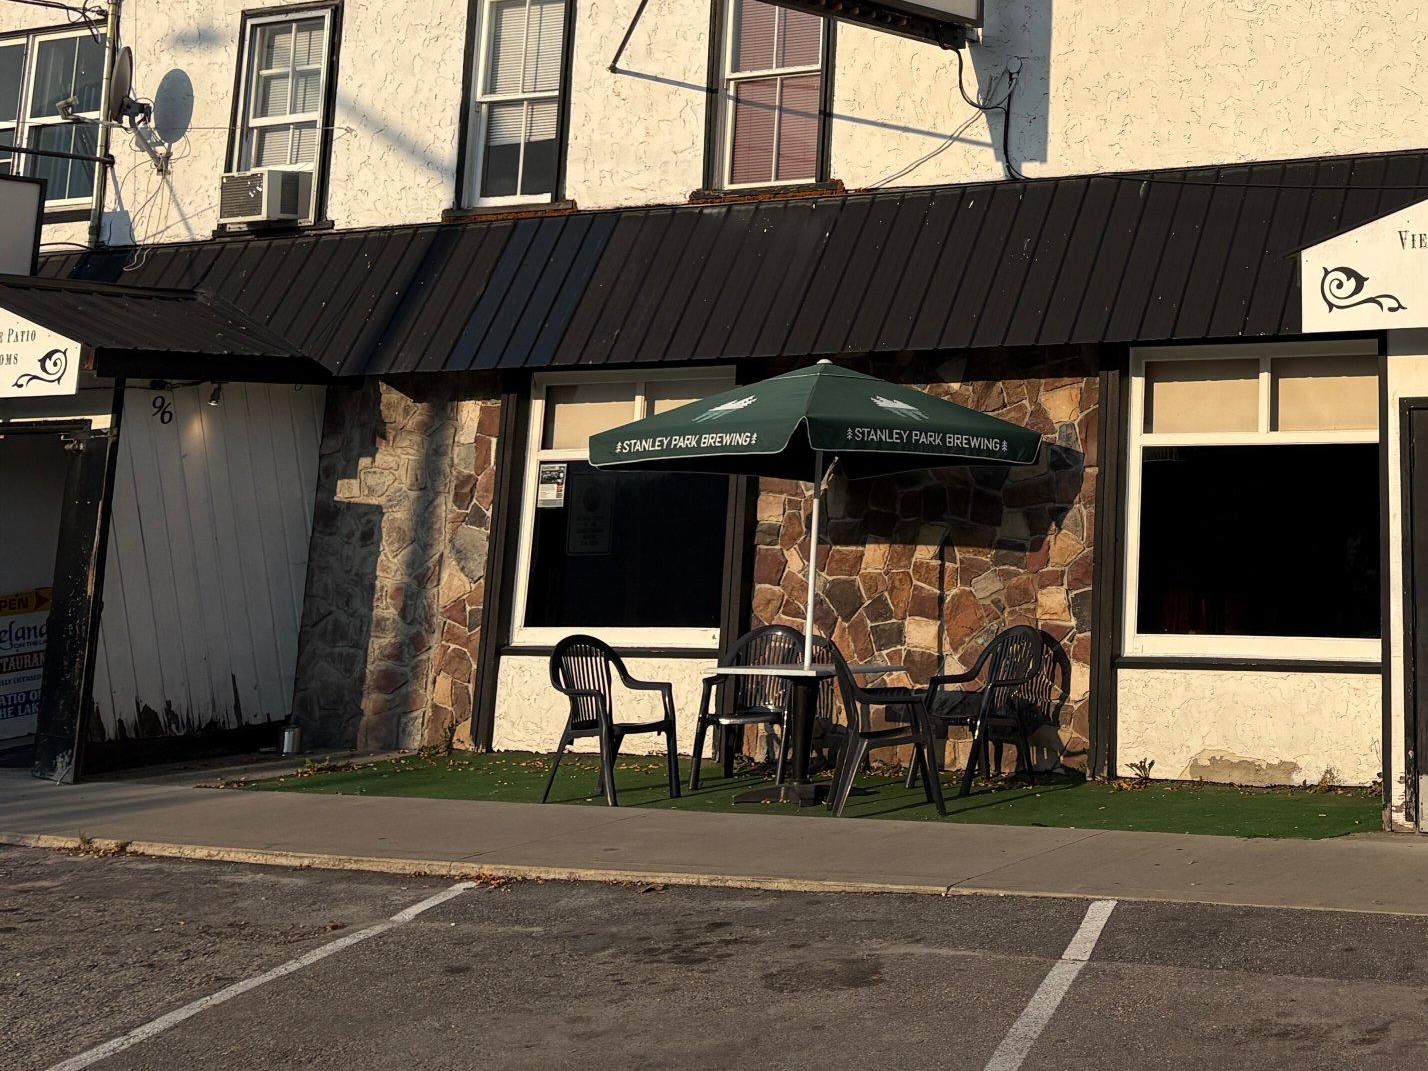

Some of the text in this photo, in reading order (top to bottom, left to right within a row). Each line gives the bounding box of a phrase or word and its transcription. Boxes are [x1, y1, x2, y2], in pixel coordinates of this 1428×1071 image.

[7, 328, 37, 343] PATIO
[0, 353, 19, 366] OMS
[622, 432, 751, 453] STANLEY PARK BREWING
[854, 428, 1000, 451] STANLEY PARK BREWING
[0, 596, 29, 611] PEN
[0, 653, 46, 672] TAURAN
[0, 692, 26, 706] ATIO
[0, 702, 39, 719] HE LAK
